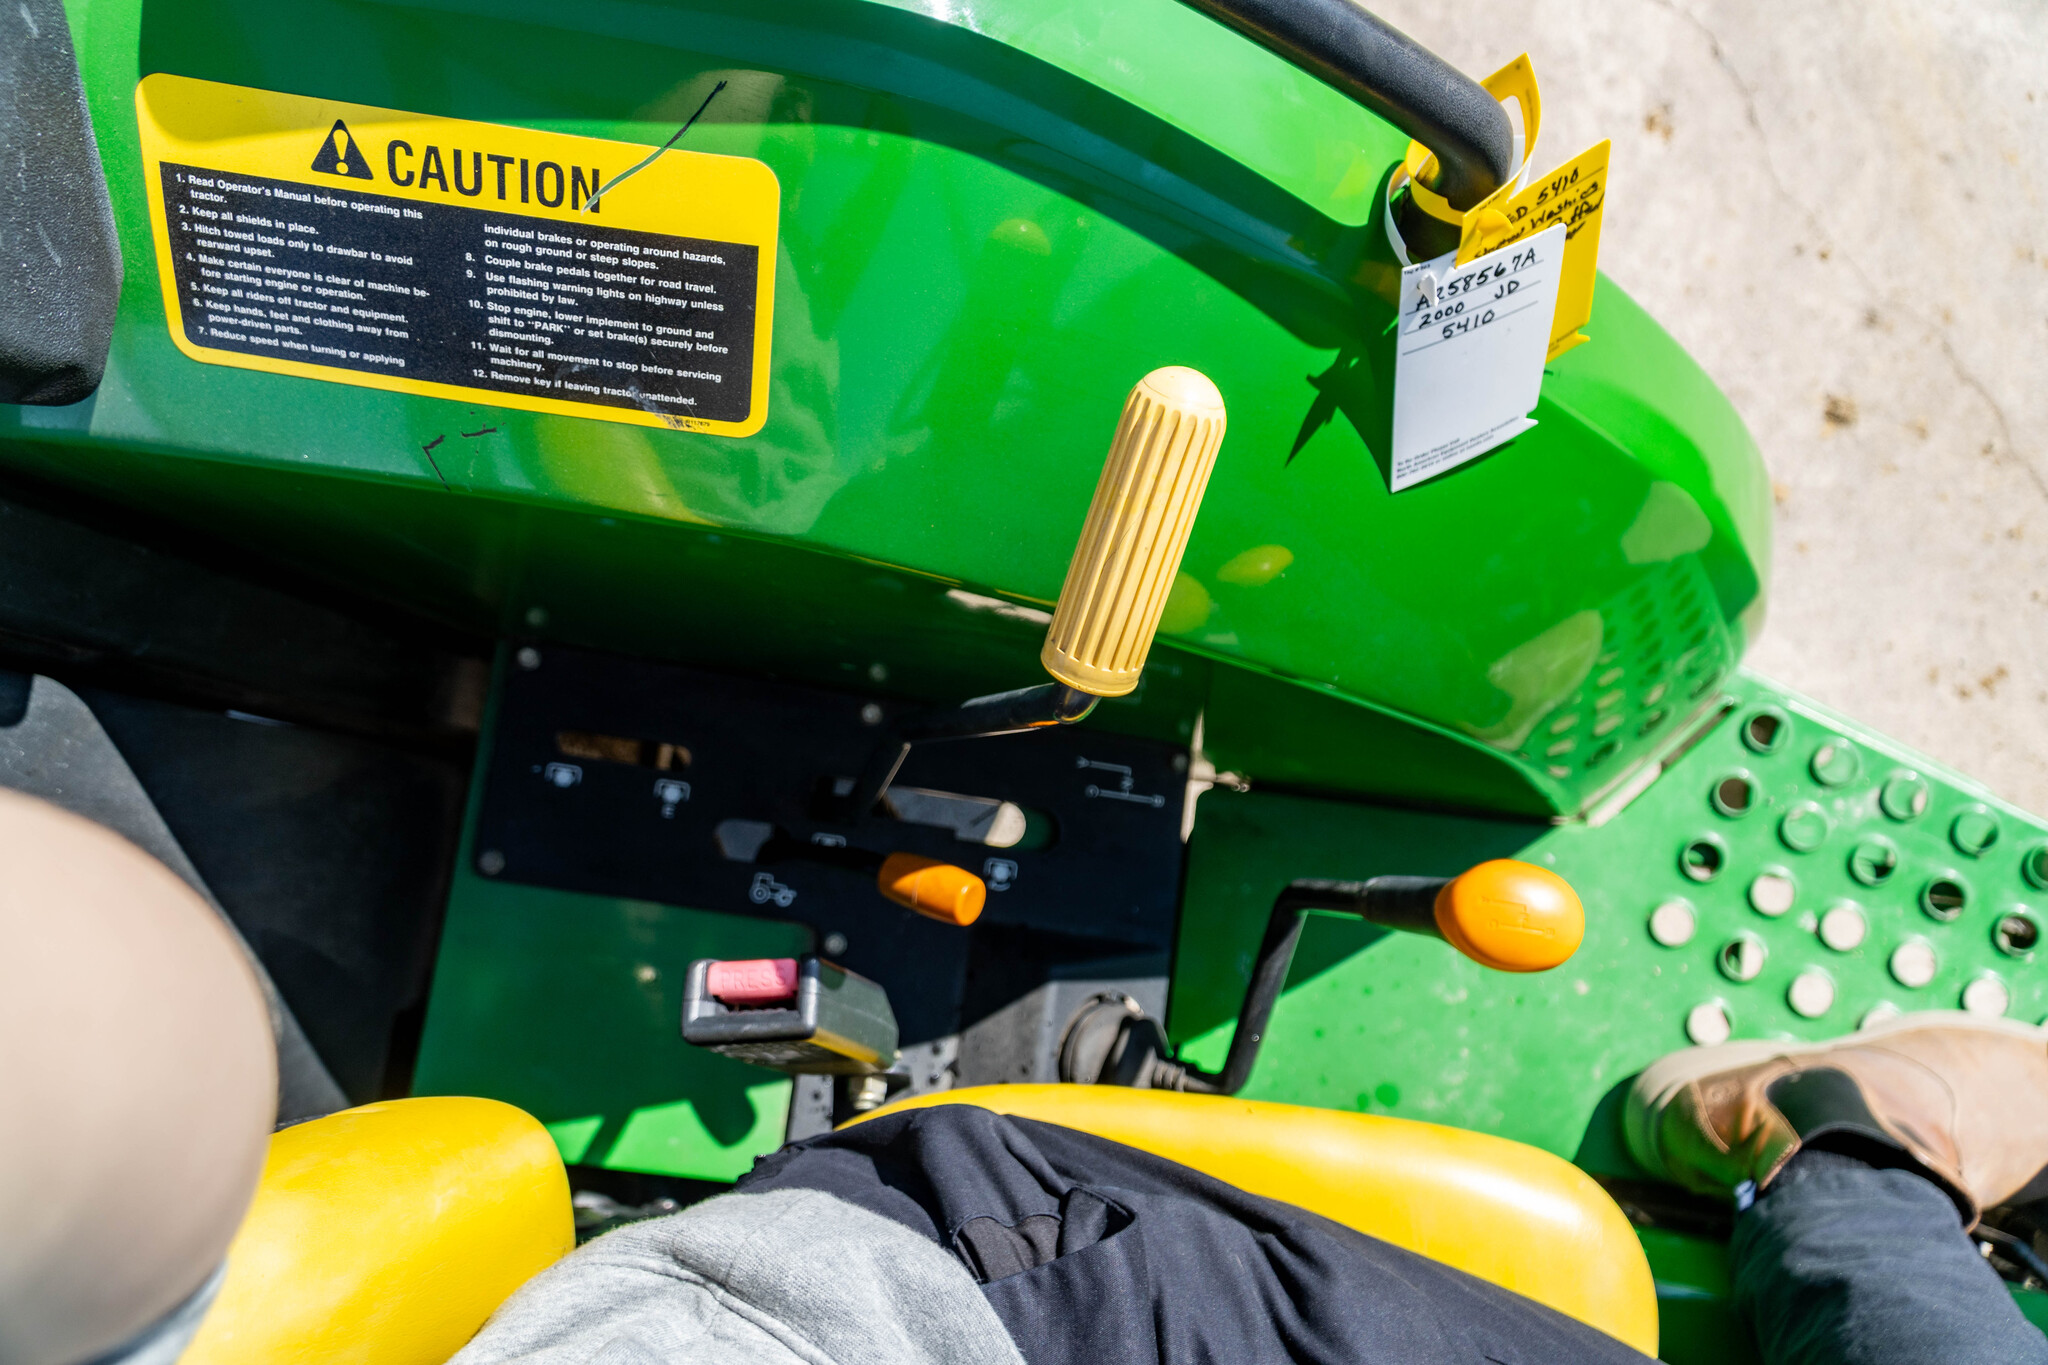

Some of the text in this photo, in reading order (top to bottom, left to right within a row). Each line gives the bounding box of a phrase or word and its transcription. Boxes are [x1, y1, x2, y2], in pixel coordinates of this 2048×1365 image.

[175, 172, 423, 219] 1. Read Operator's Manual before operating this
[387, 139, 600, 213] CAUTION
[1536, 167, 1578, 205] 5410
[189, 189, 227, 203] tractor.
[178, 204, 319, 234] 2. Keep all shields in place.
[181, 221, 413, 265] 3. Hitch towed loads only to drawbar to avoid
[196, 238, 275, 257] rearward upset.
[484, 223, 725, 265] individual brakes or operating around hazards,
[484, 239, 658, 269] on rough ground or steep slopes.
[185, 252, 429, 296] 4. Make certain everyone is clear of machine be-
[200, 267, 366, 300] fore starting engine or operation.
[465, 252, 716, 293] 8. Couple brake pedals together for road travel.
[465, 269, 724, 311] 9. Use flashing warning lights on highway unless
[190, 281, 408, 322] 5. Keep all riders off tractor and equipment.
[486, 286, 578, 305] prohibited by law.
[1418, 280, 1520, 330] 2000 JD
[192, 297, 408, 338] 6. Keep hands, feet and clothing away from
[207, 313, 302, 334] power-driven parts.
[468, 299, 714, 339] 10. Stop engine, lower implement to ground and
[487, 315, 510, 325] shift
[513, 318, 524, 327] to
[573, 327, 585, 335] or
[587, 329, 603, 338] set
[606, 330, 647, 345] brake(s)
[650, 337, 693, 351] securely
[695, 342, 728, 354] before
[488, 327, 554, 345] dismounting.
[1442, 309, 1495, 339] 5410
[198, 325, 405, 367] 7. Reduce speed when turning or applying
[470, 341, 721, 383] 11. Wait for all movement to stop before servicing
[490, 357, 545, 371] machinery.
[472, 368, 487, 378] 12.
[490, 370, 531, 384] Remove
[533, 376, 551, 388] key
[554, 379, 561, 387] if
[564, 380, 600, 394] leaving
[720, 965, 787, 992] PRESS
